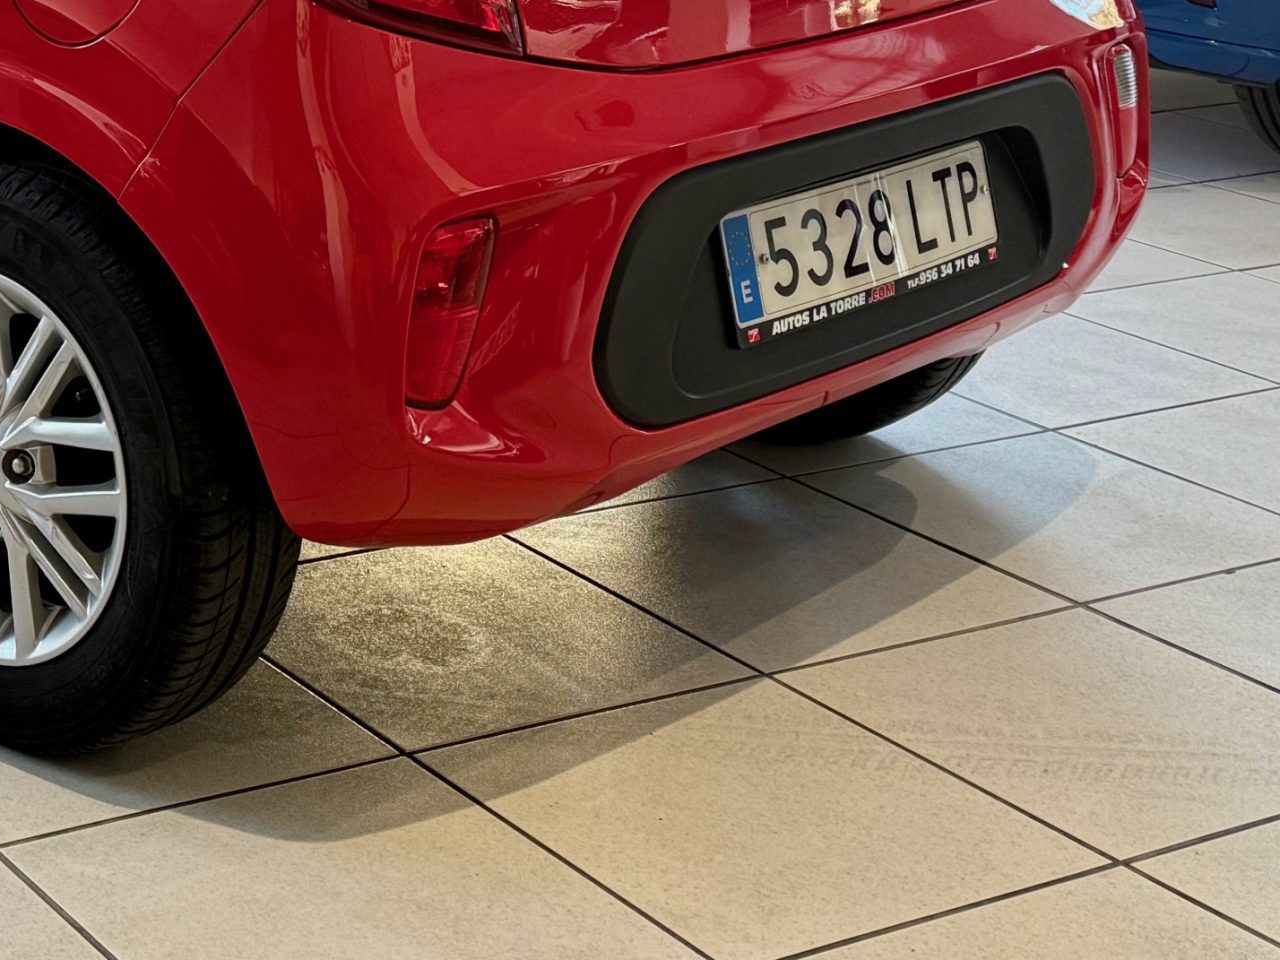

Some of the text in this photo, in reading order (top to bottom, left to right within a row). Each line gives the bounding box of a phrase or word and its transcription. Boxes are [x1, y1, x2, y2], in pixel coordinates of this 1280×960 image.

[764, 160, 978, 297] 5328 LTP
[740, 280, 754, 304] E
[772, 311, 811, 336] AUTOS
[812, 304, 829, 322] LA
[829, 292, 866, 316] TORRE
[939, 262, 954, 278] 34
[954, 257, 966, 272] 71
[966, 252, 981, 268] 64
